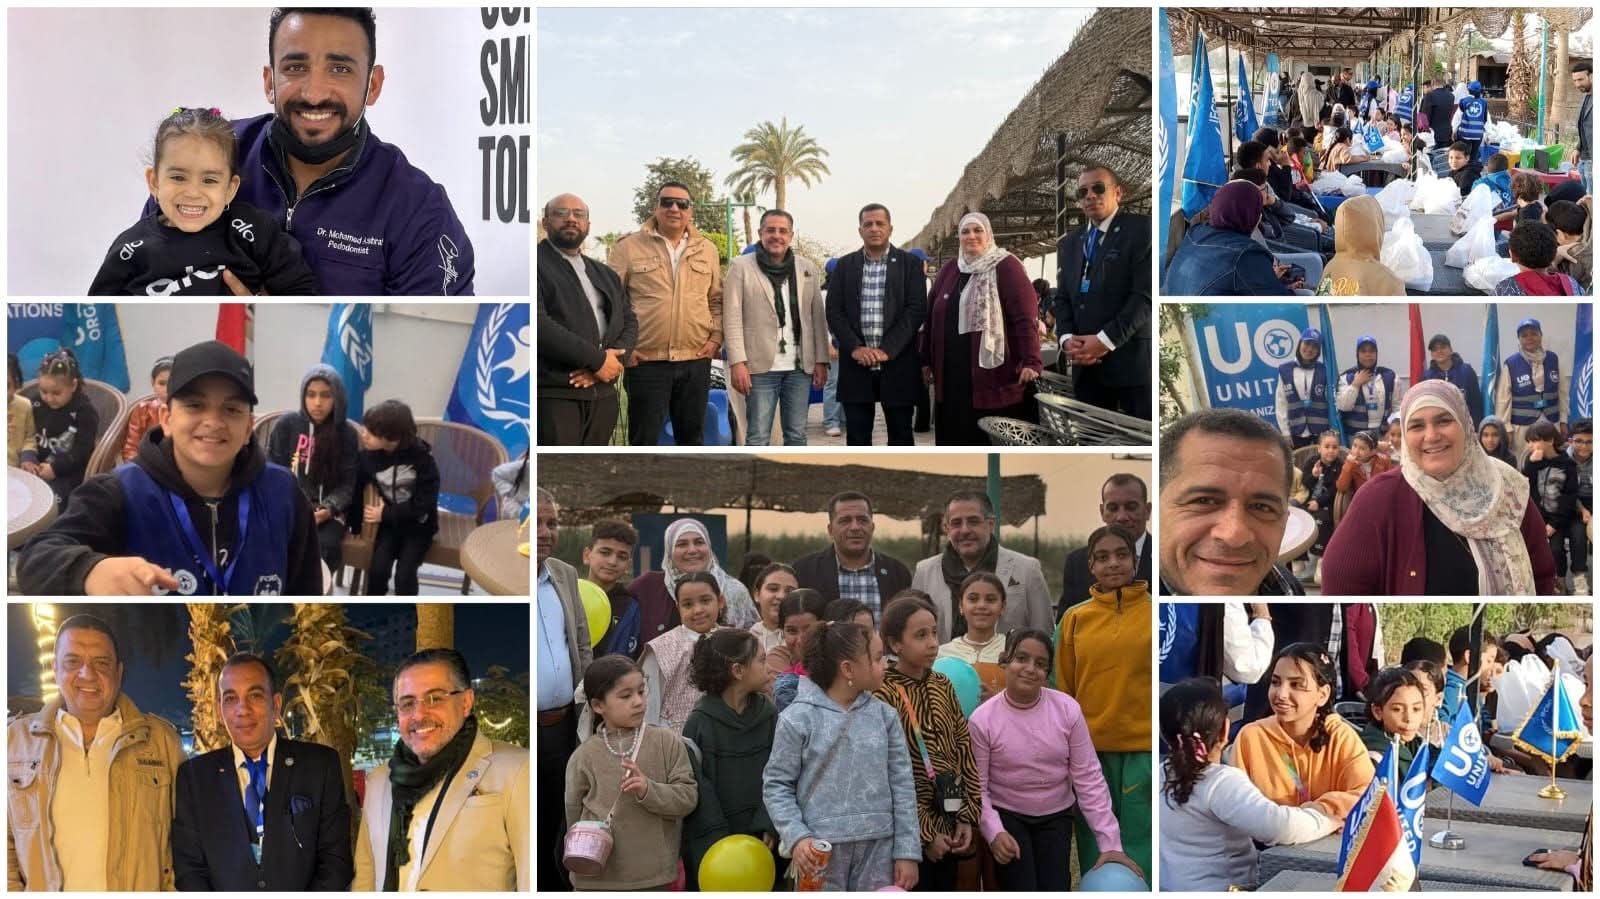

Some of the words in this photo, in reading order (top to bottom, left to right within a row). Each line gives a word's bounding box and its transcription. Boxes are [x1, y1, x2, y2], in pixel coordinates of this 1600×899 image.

[231, 218, 255, 242] alo
[316, 227, 328, 237] Dr.
[328, 229, 363, 245] Mohamed
[119, 240, 144, 260] alo
[327, 239, 369, 255] Pedodontist
[1444, 722, 1482, 777] UO
